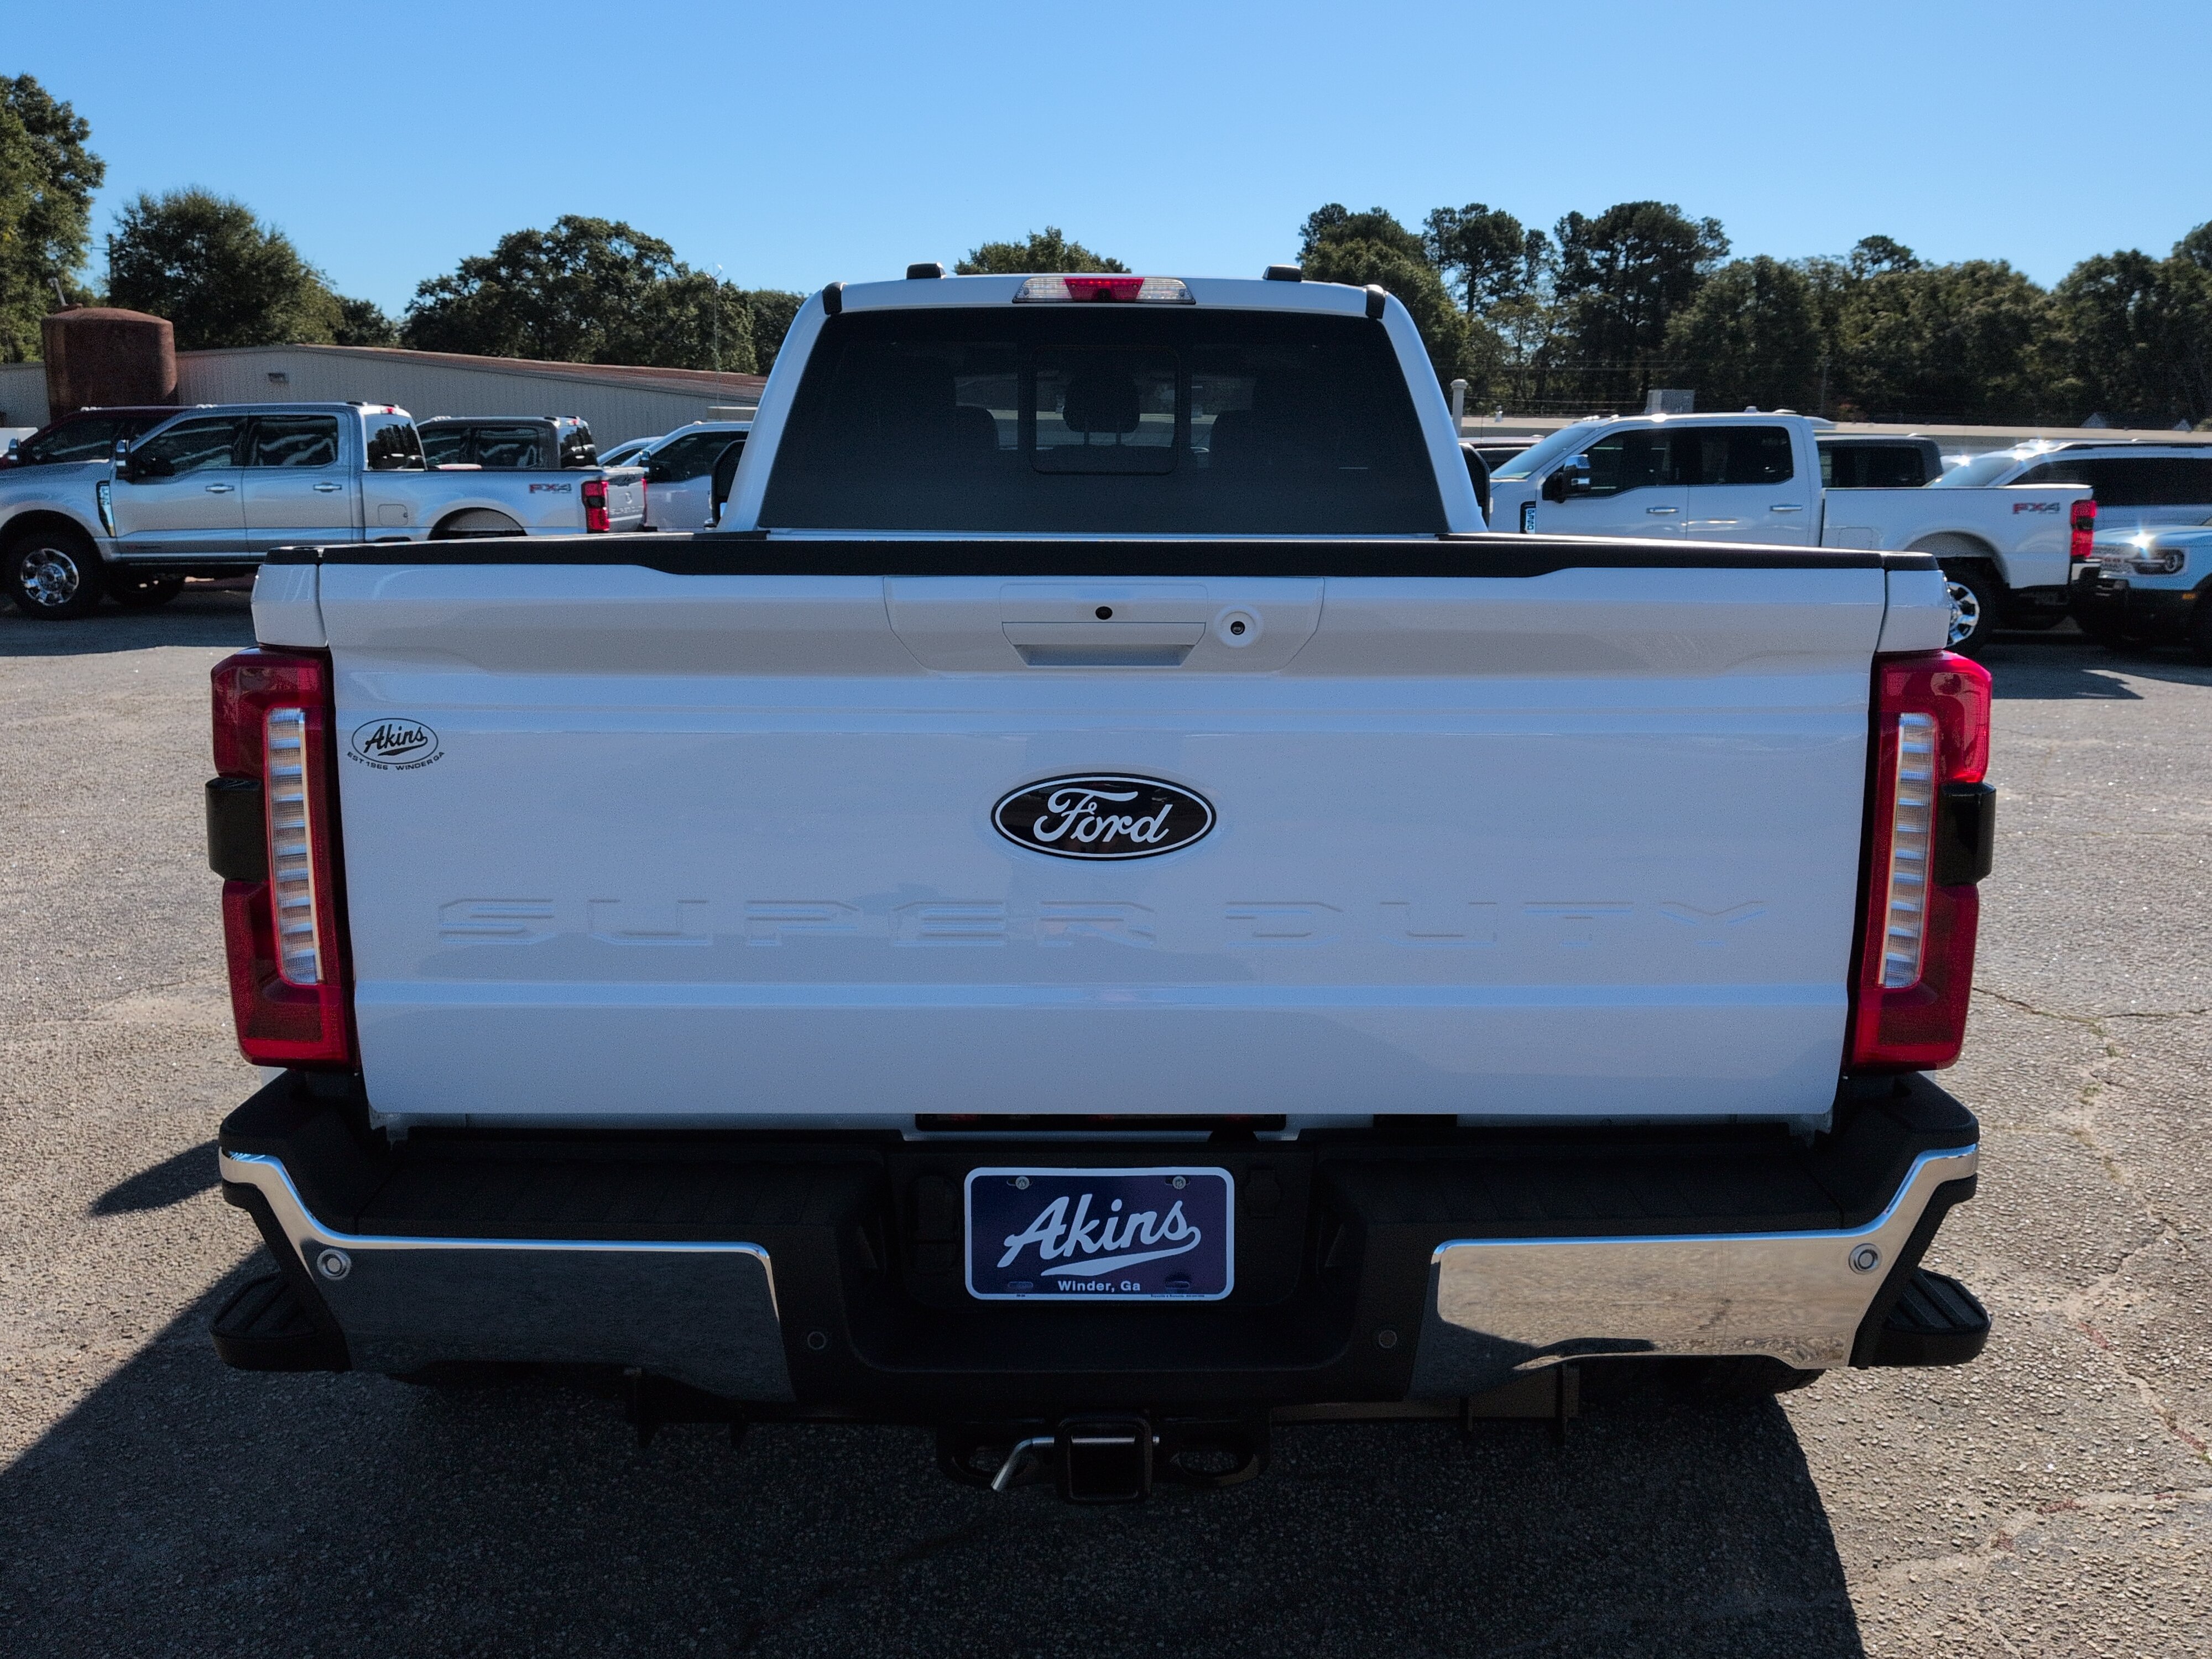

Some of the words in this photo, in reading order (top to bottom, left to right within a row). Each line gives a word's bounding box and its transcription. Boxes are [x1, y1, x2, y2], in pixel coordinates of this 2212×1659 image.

[529, 483, 572, 494] FX4
[2012, 502, 2060, 514] FX4
[363, 724, 428, 755] Akins
[347, 751, 364, 764] EST
[395, 759, 434, 770] WINDER
[433, 752, 445, 761] GA
[1034, 788, 1172, 843] Ford
[437, 898, 1155, 947] SUPER
[1224, 899, 1770, 948] DUTY
[997, 1194, 1201, 1276] Akins
[1058, 1280, 1114, 1292] Winder,
[1120, 1280, 1141, 1291] Ga
